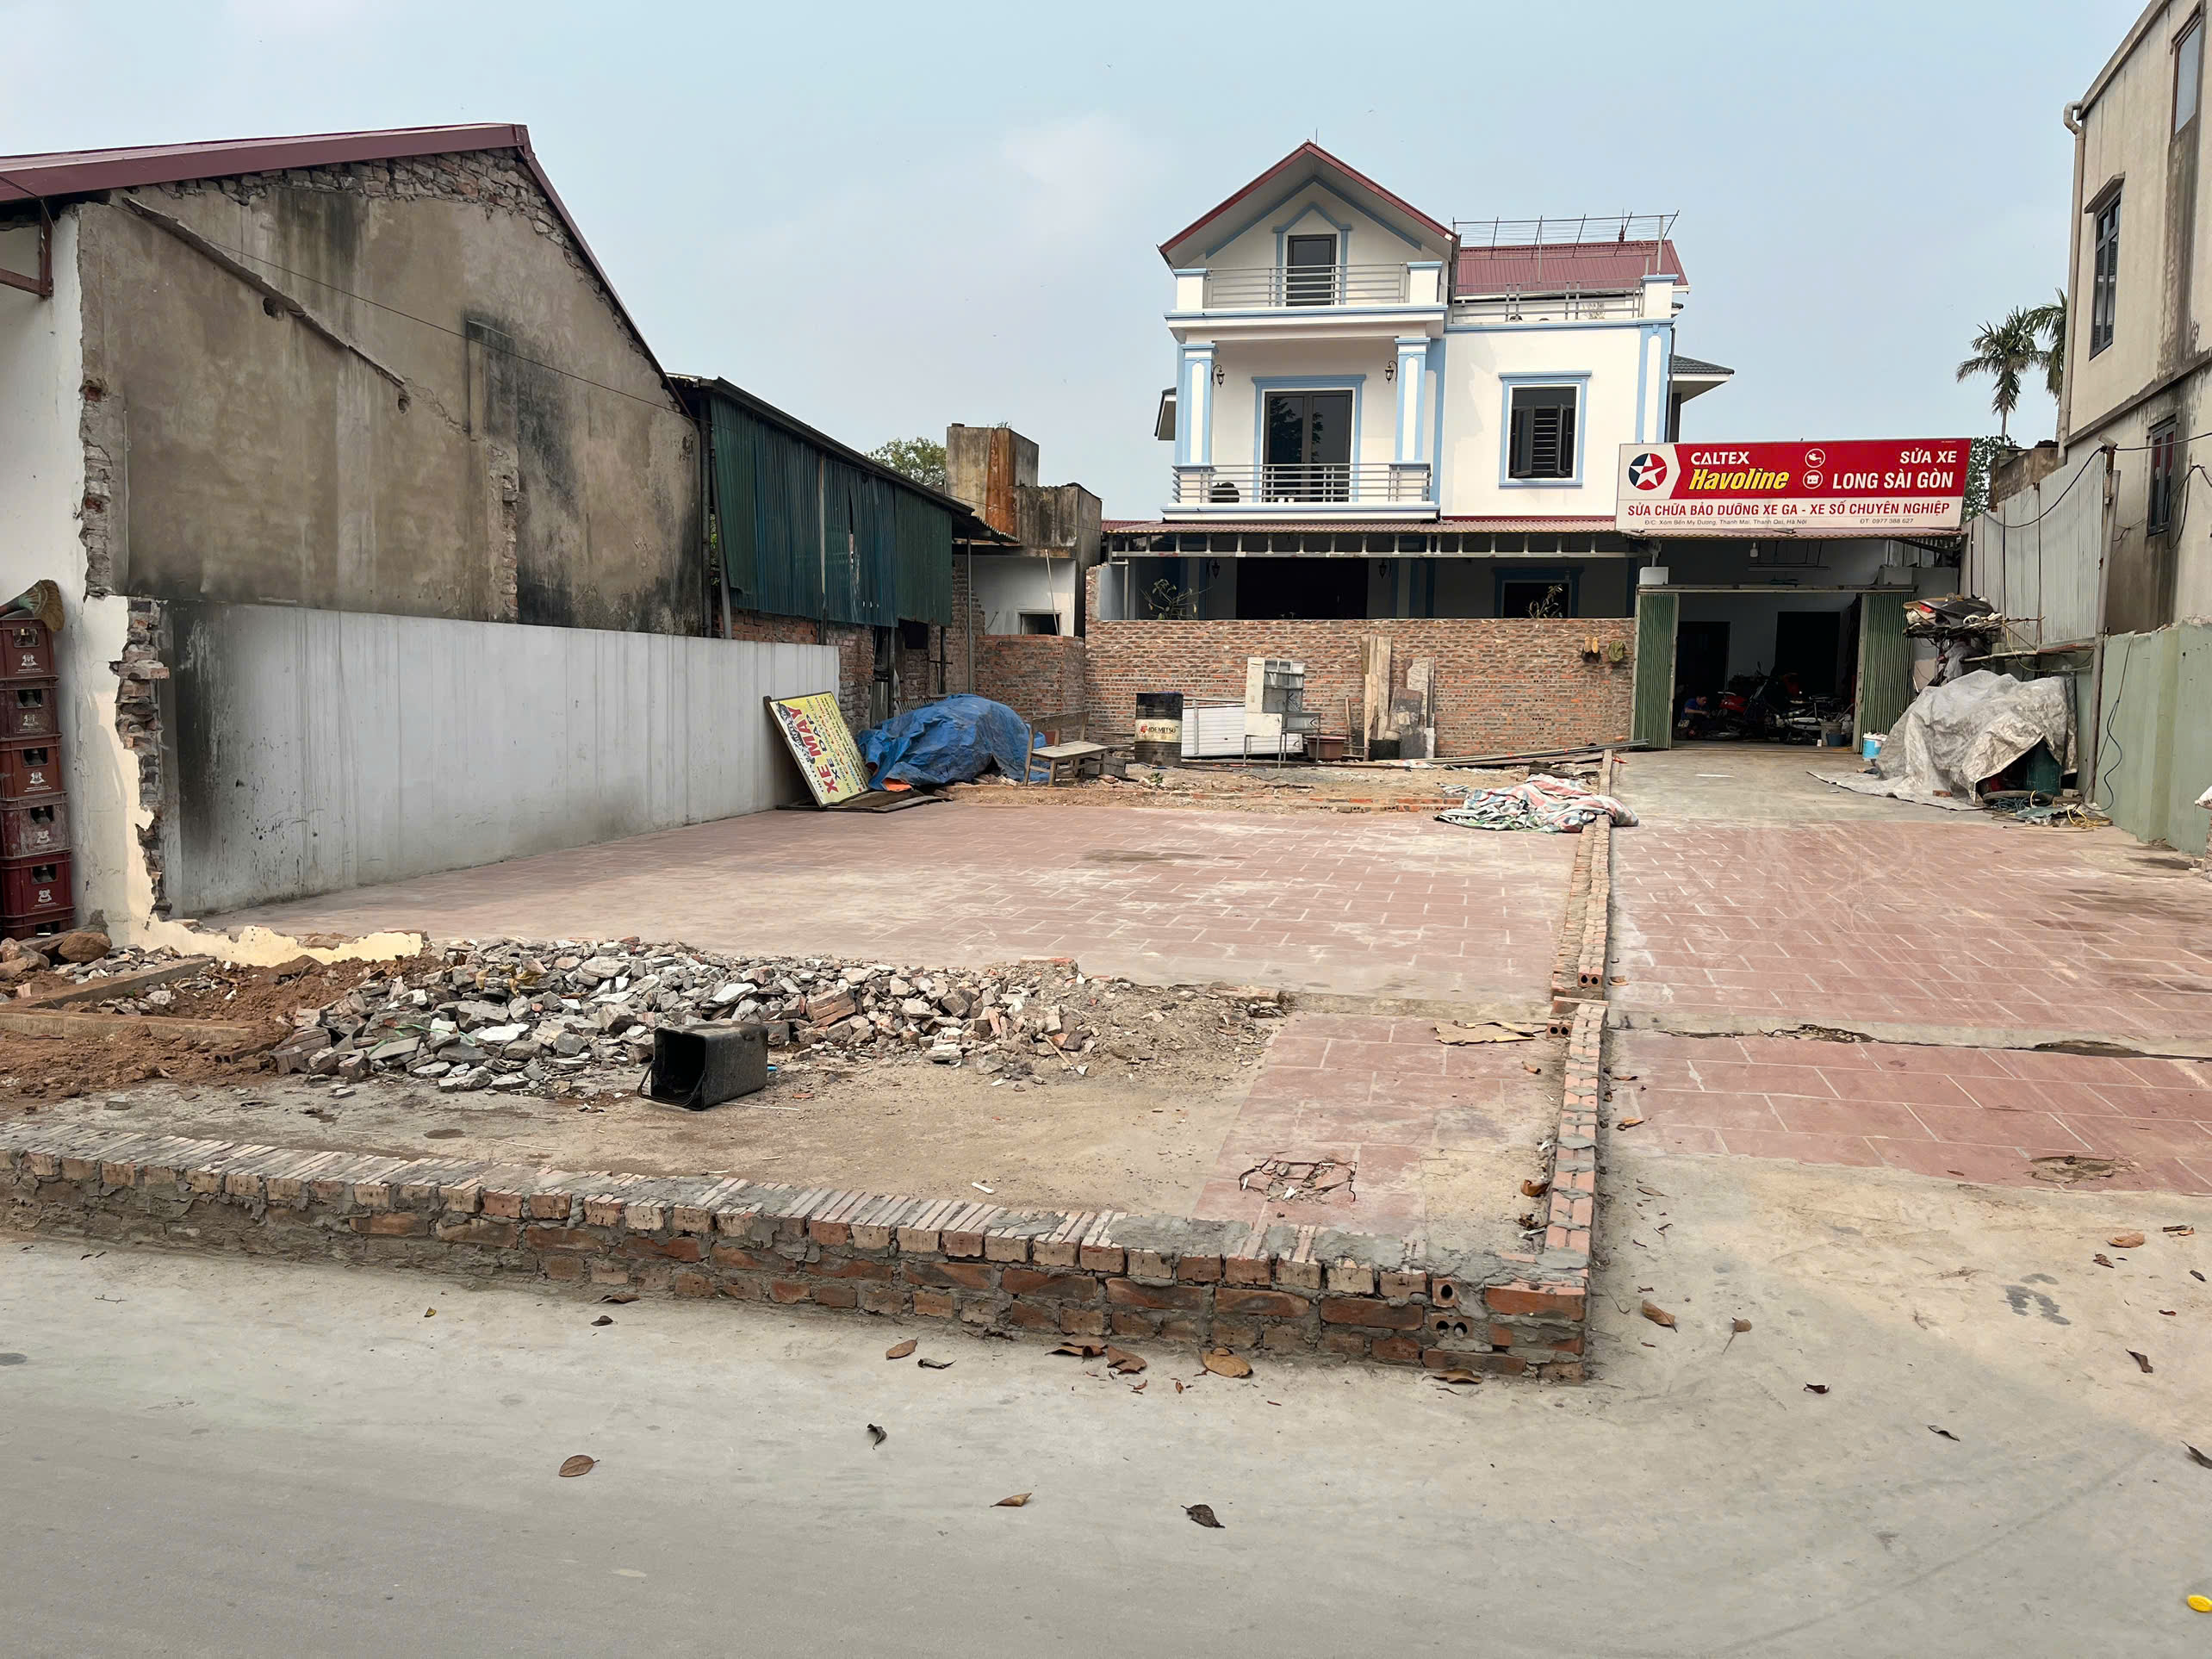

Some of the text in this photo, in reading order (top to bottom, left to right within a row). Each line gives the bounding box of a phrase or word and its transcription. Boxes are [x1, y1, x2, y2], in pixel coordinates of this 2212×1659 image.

[1690, 450, 1750, 465] CALTEX
[1899, 447, 1957, 463] SỬA XE
[1688, 468, 1791, 491] Havoline
[1832, 468, 1954, 489] LONG SÀI GÒN
[1627, 502, 1651, 516] SỬA
[1655, 502, 1687, 516] CHỮA
[1690, 501, 1714, 516] BẢO
[1717, 502, 1759, 516] DƯỠNG
[1762, 505, 1778, 515] XE
[1782, 504, 1798, 515] GA
[1810, 504, 1825, 515] XE
[1829, 500, 1847, 514] SỐ
[1849, 500, 1900, 514] CHUYÊN
[1903, 500, 1950, 516] NGHIỆP
[817, 764, 839, 794] XE
[826, 757, 841, 780] XE
